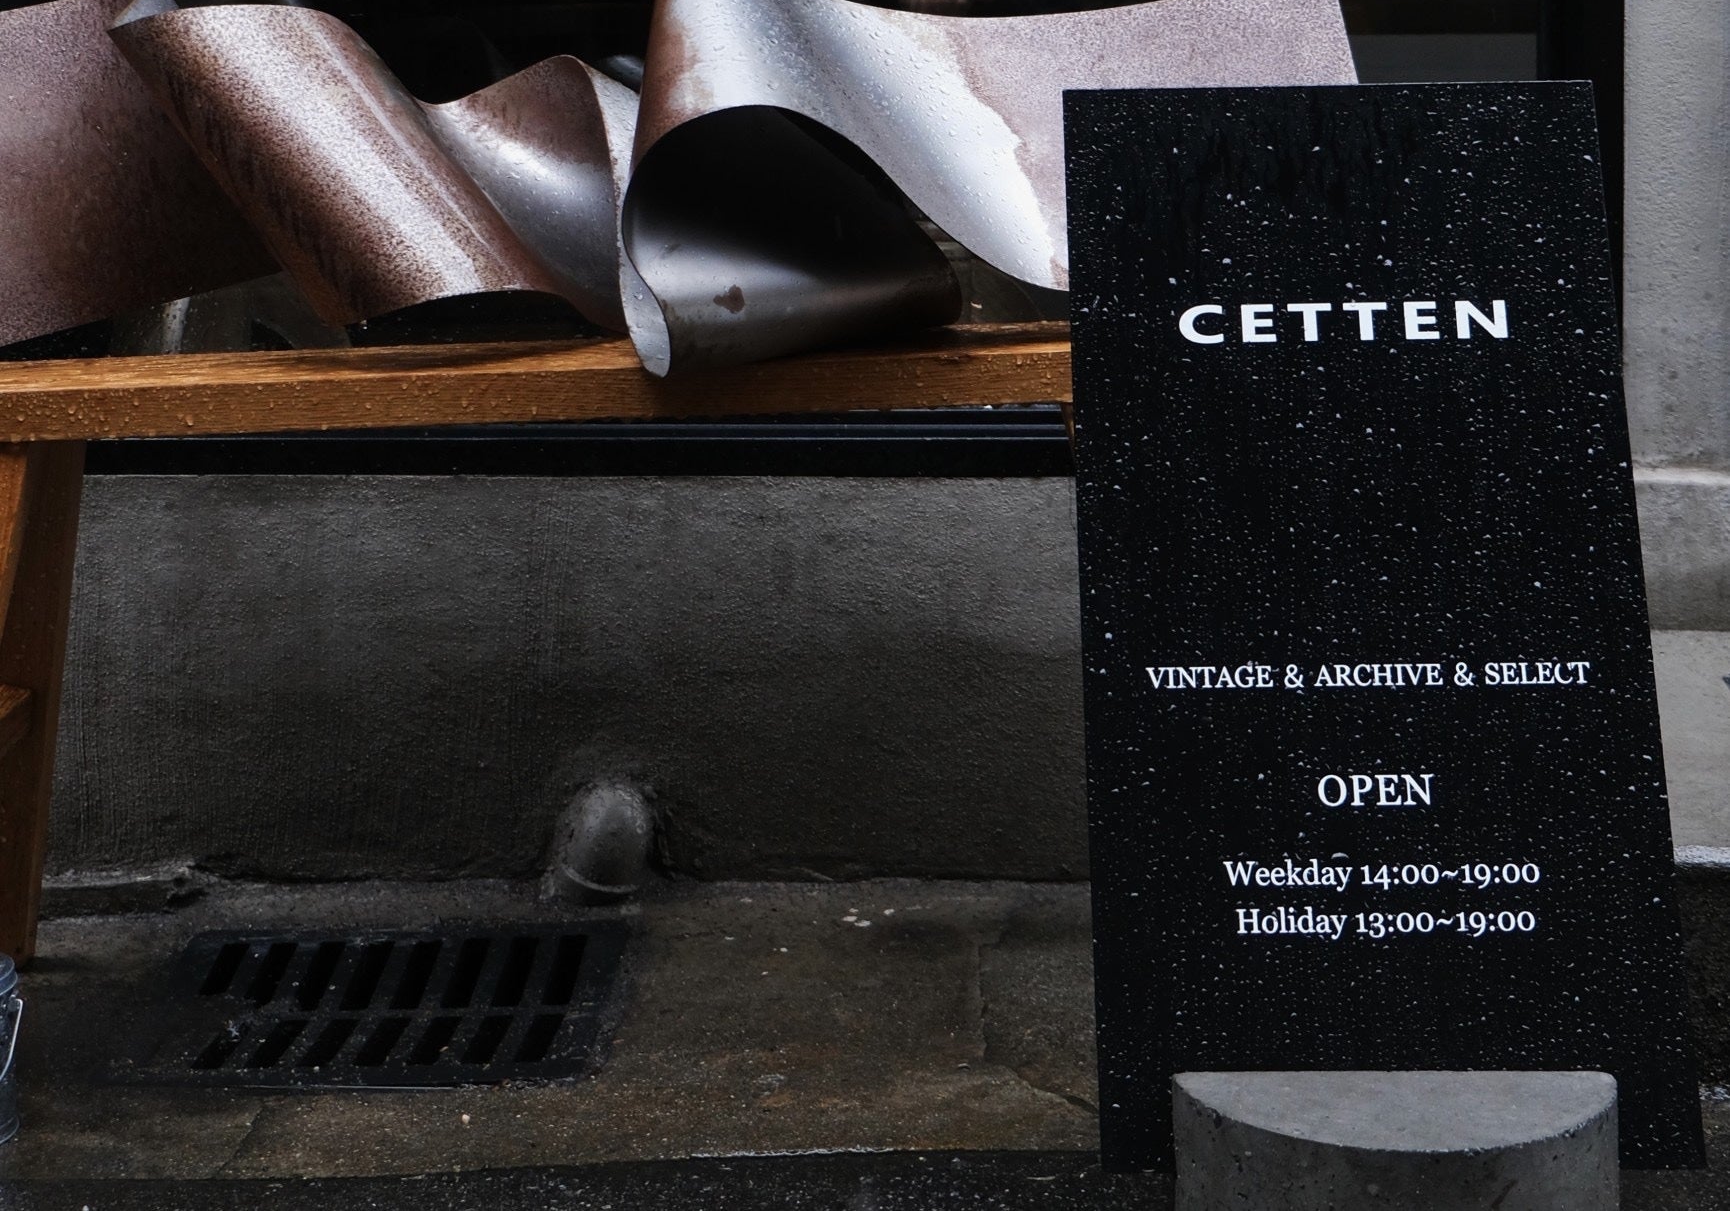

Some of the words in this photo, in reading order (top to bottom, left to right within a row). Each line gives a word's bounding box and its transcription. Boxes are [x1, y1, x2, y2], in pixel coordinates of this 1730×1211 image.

[1179, 300, 1508, 344] CETTEN
[1146, 665, 1273, 689] VINTAGE
[1284, 664, 1304, 688] &
[1314, 664, 1443, 688] ARCHIVE
[1454, 662, 1475, 686] &
[1484, 662, 1590, 686] SELECT
[1317, 774, 1434, 806] OPEN
[1223, 859, 1352, 891] Weekday
[1236, 906, 1347, 939] Holiday
